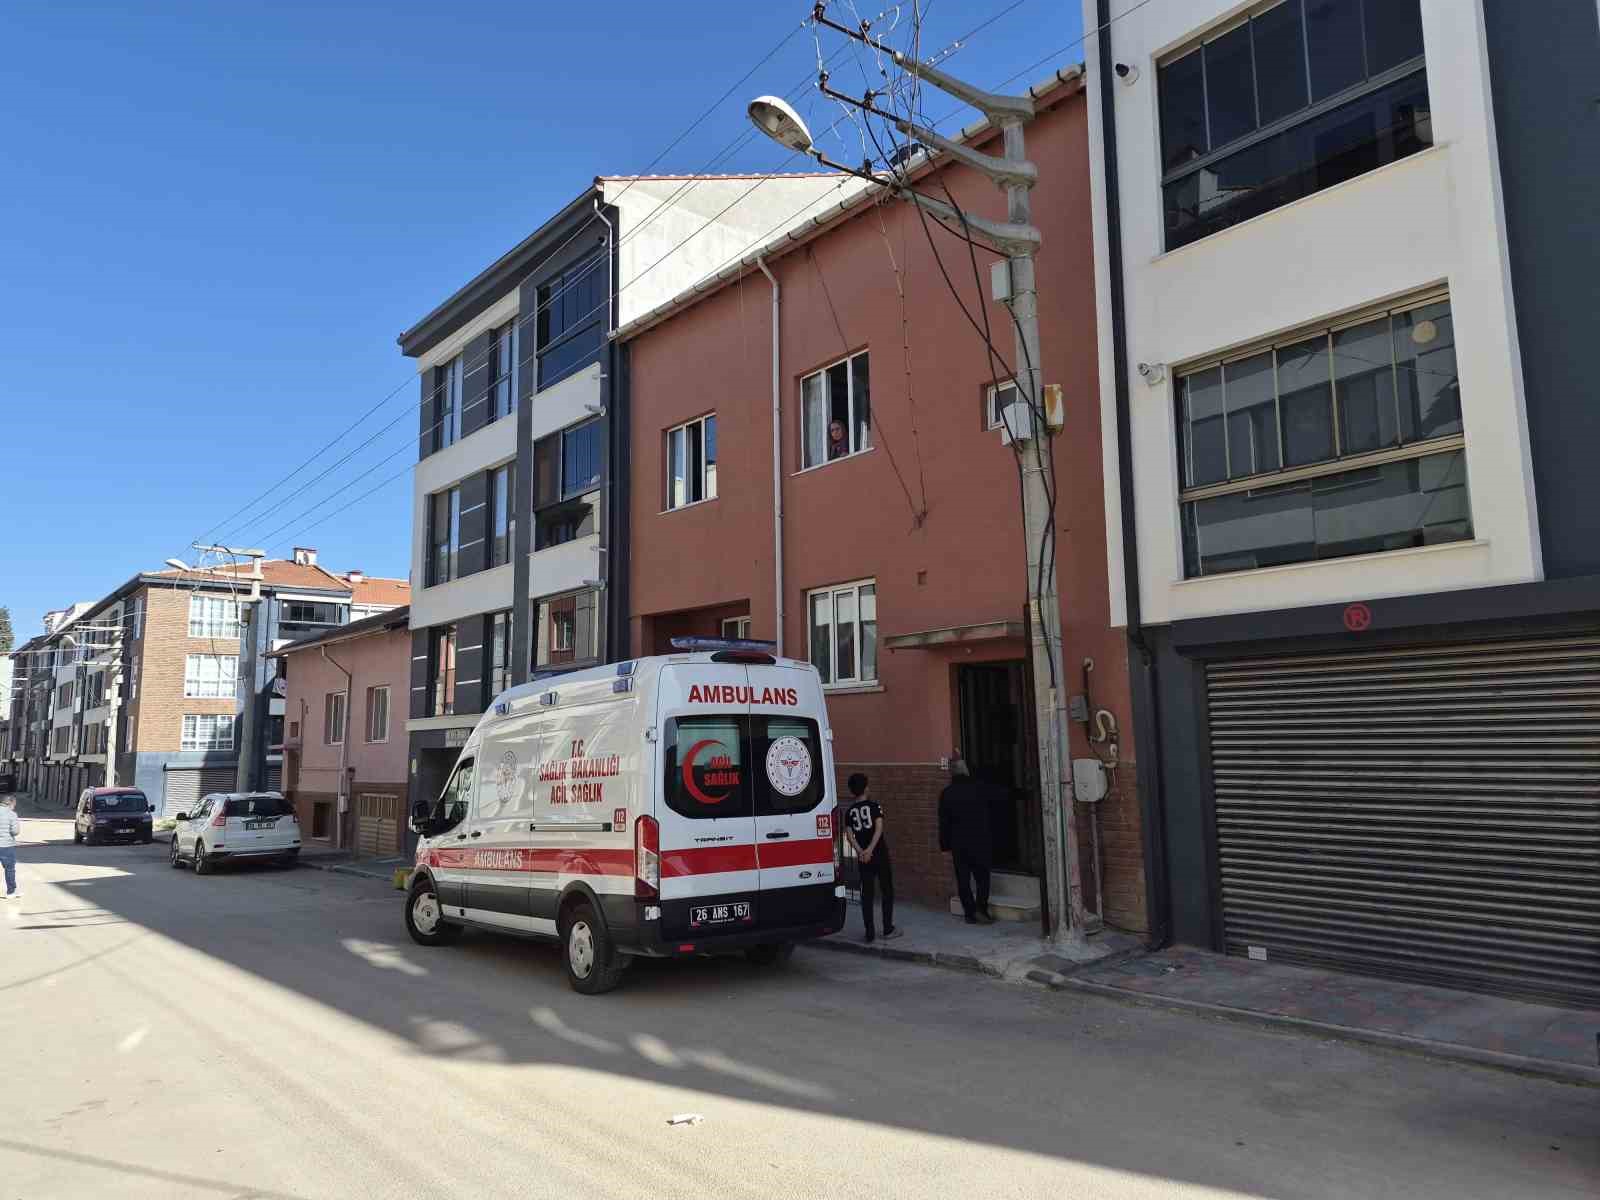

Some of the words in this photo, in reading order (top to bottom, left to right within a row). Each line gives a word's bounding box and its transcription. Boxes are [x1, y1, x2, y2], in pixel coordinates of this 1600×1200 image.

[688, 685, 798, 706] AMBULANS
[571, 740, 585, 758] T.C.
[539, 760, 567, 782] SAĞLIK
[571, 754, 620, 779] BAKANLIĞI
[571, 781, 603, 803] SAĞLIK
[850, 805, 872, 831] 39
[474, 849, 522, 869] AMBULANS
[696, 909, 707, 920] 26
[734, 904, 748, 917] 167
